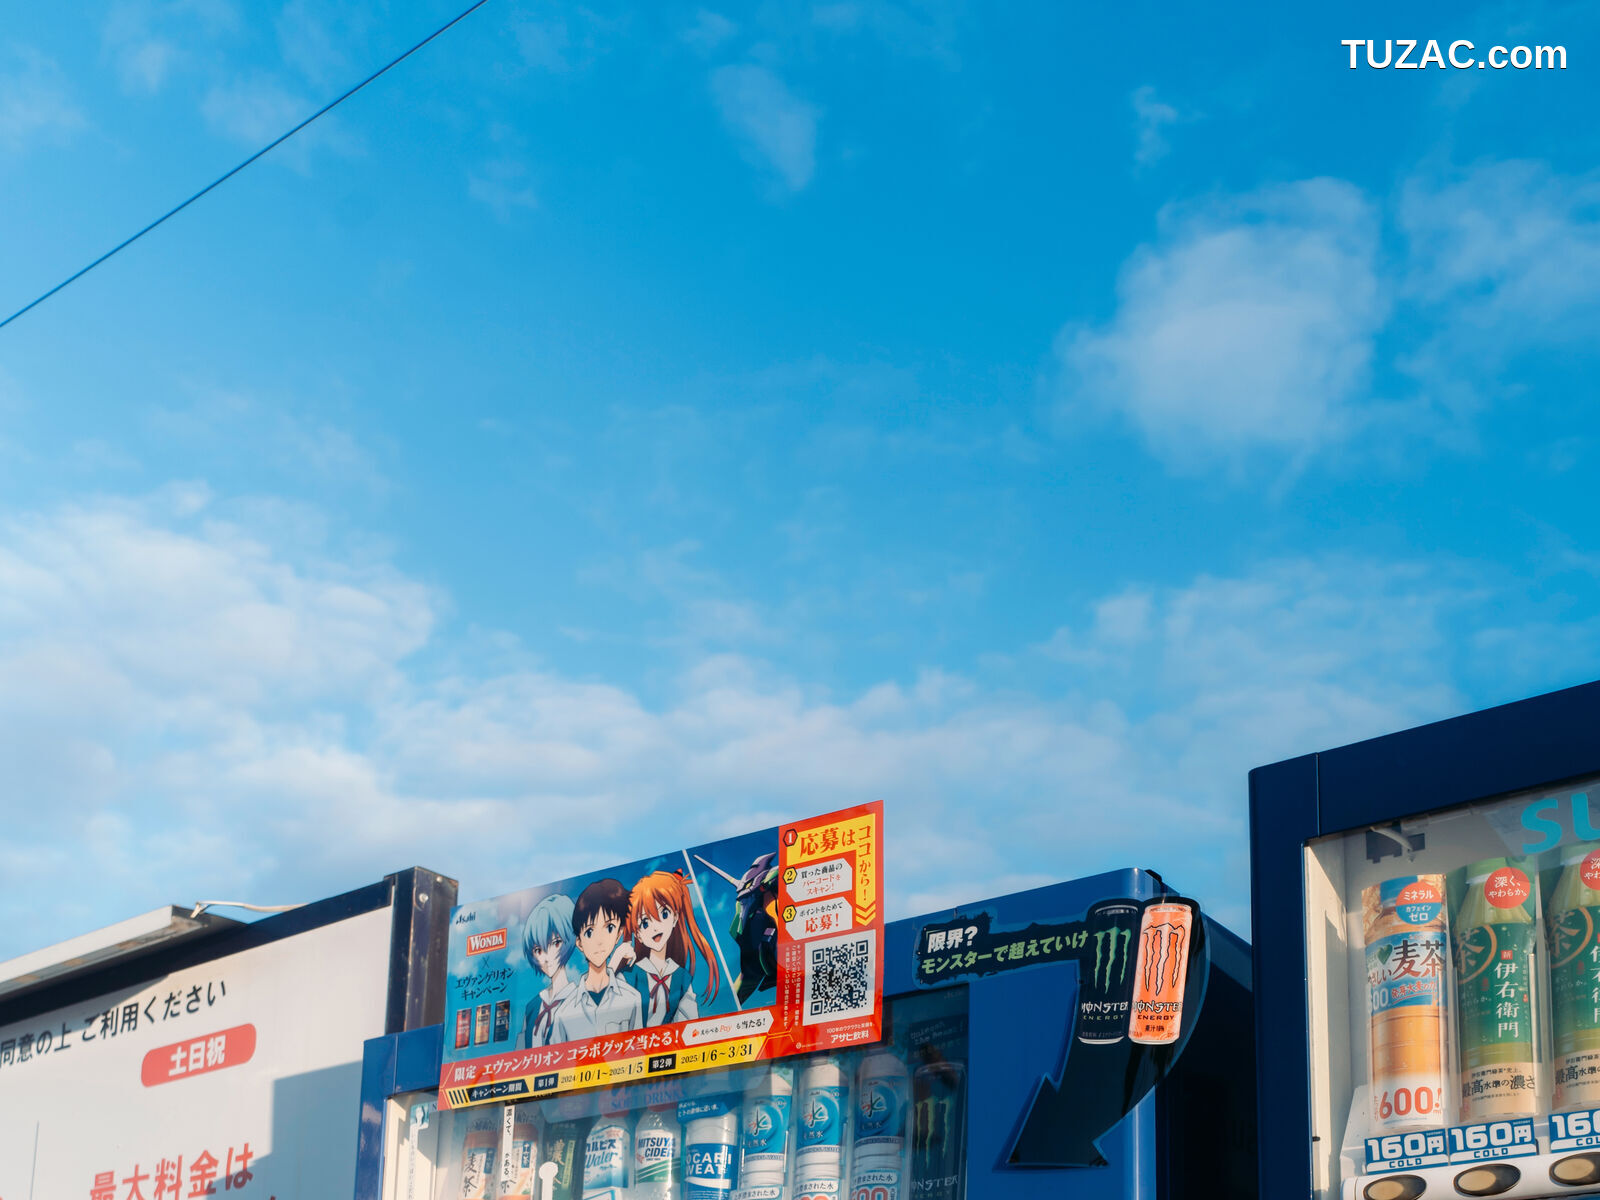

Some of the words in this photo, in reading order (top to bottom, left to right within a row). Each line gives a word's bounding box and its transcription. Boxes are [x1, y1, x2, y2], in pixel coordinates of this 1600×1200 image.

[800, 827, 856, 858] 応募は
[801, 862, 843, 879] 買った商品の
[803, 874, 841, 888] バーコードを
[1403, 890, 1434, 901] ミネラル
[800, 901, 843, 917] ポイントをためて
[1405, 905, 1432, 913] カフェイン
[1409, 912, 1429, 922] ゼロ
[469, 933, 504, 951] WONDA
[921, 930, 1089, 975] モンスターで超えていけ
[1391, 939, 1445, 981] 麦茶
[456, 968, 515, 988] エヴァンゲリオン
[461, 982, 508, 1001] キャンペーン
[1494, 962, 1519, 1039] 伊右衛門
[81, 979, 227, 1043] ご利用ください
[831, 1030, 869, 1044] アサヒ飲料
[168, 1035, 227, 1077] 土日祝
[454, 1064, 476, 1083] 限定
[482, 1051, 563, 1076] エヴァンゲリオン
[471, 1084, 522, 1099] キャンペーン期間
[537, 1076, 555, 1089] 第1弾
[652, 1057, 673, 1070] 第2弾
[1451, 1121, 1532, 1152] 160円
[1367, 1133, 1442, 1162] 160円
[1473, 1147, 1509, 1159] COLD
[1389, 1157, 1423, 1169] COLD
